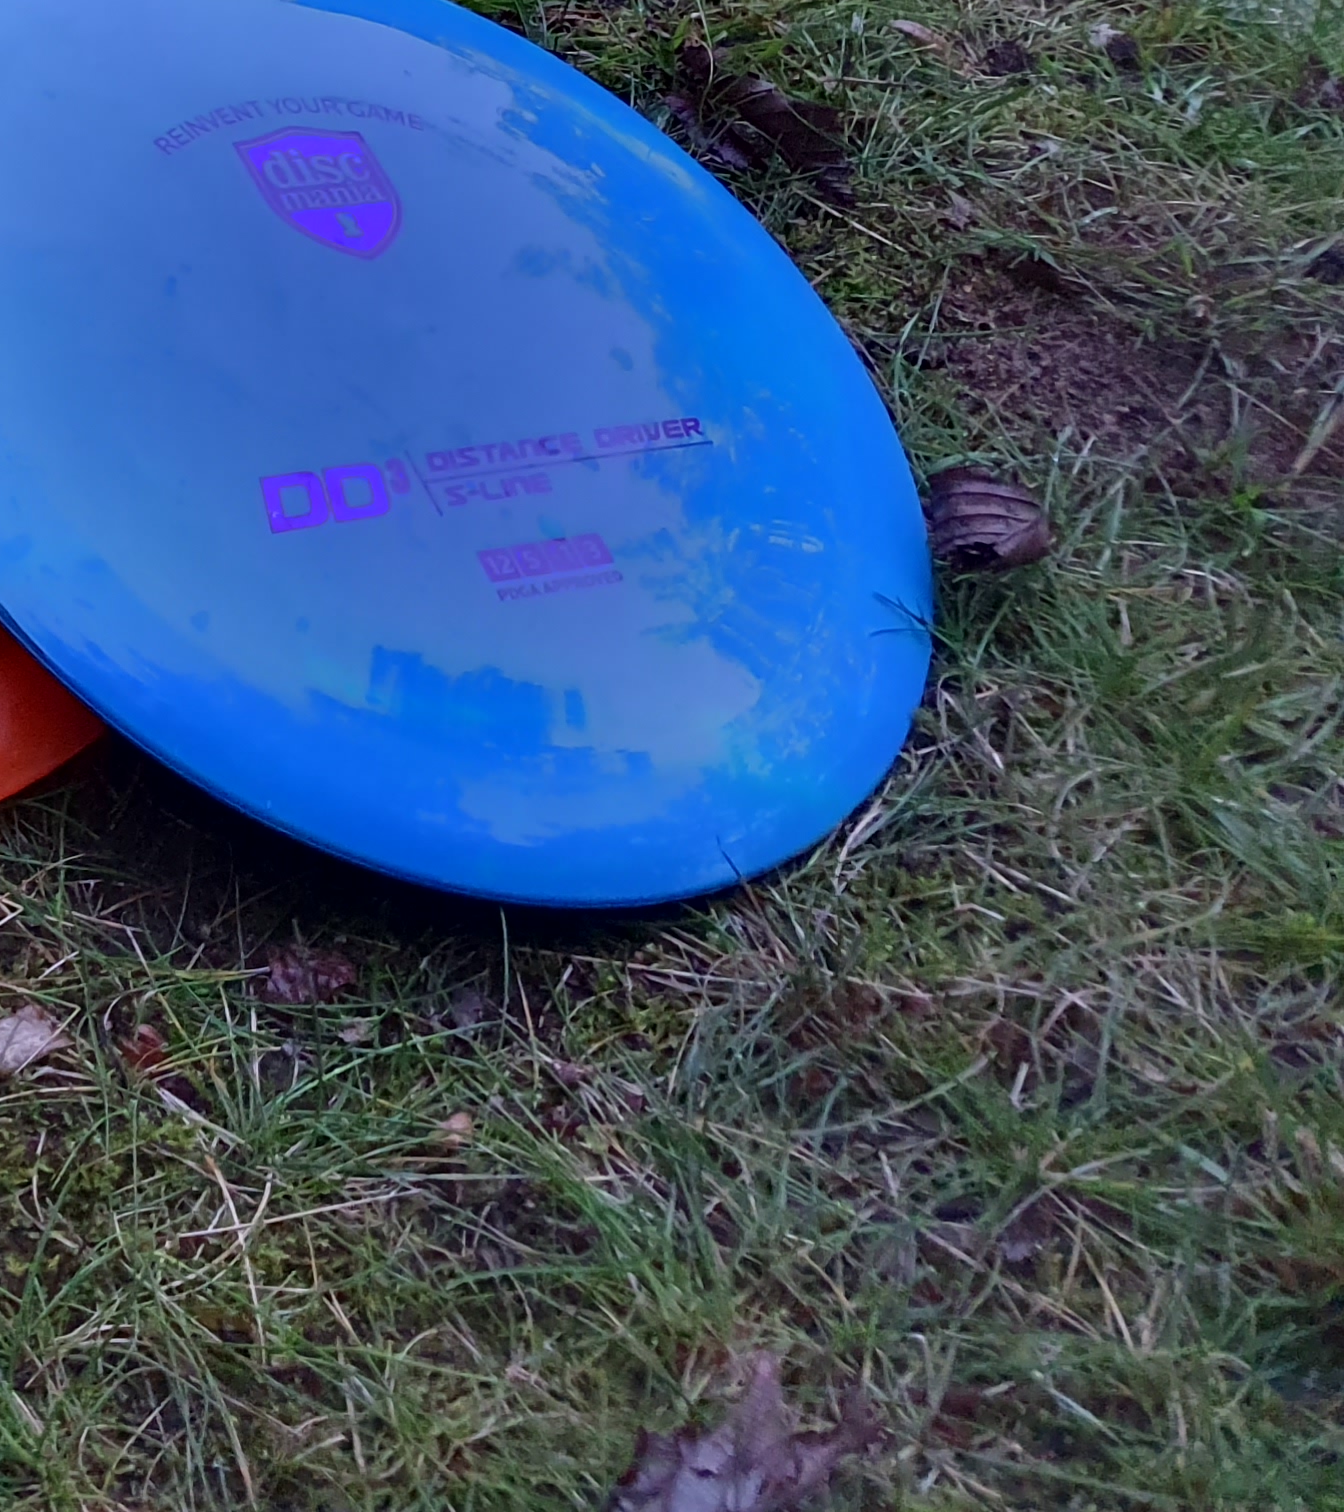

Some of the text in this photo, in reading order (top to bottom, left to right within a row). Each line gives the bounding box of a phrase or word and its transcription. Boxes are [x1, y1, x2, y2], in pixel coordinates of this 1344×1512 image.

[153, 96, 426, 155] REINVENT YOUR GAME
[262, 148, 371, 189] disc
[279, 182, 387, 212] mania
[424, 416, 707, 473] DISTANCE DRIVER
[443, 472, 554, 507] S-LINE
[496, 583, 540, 601] PDGA
